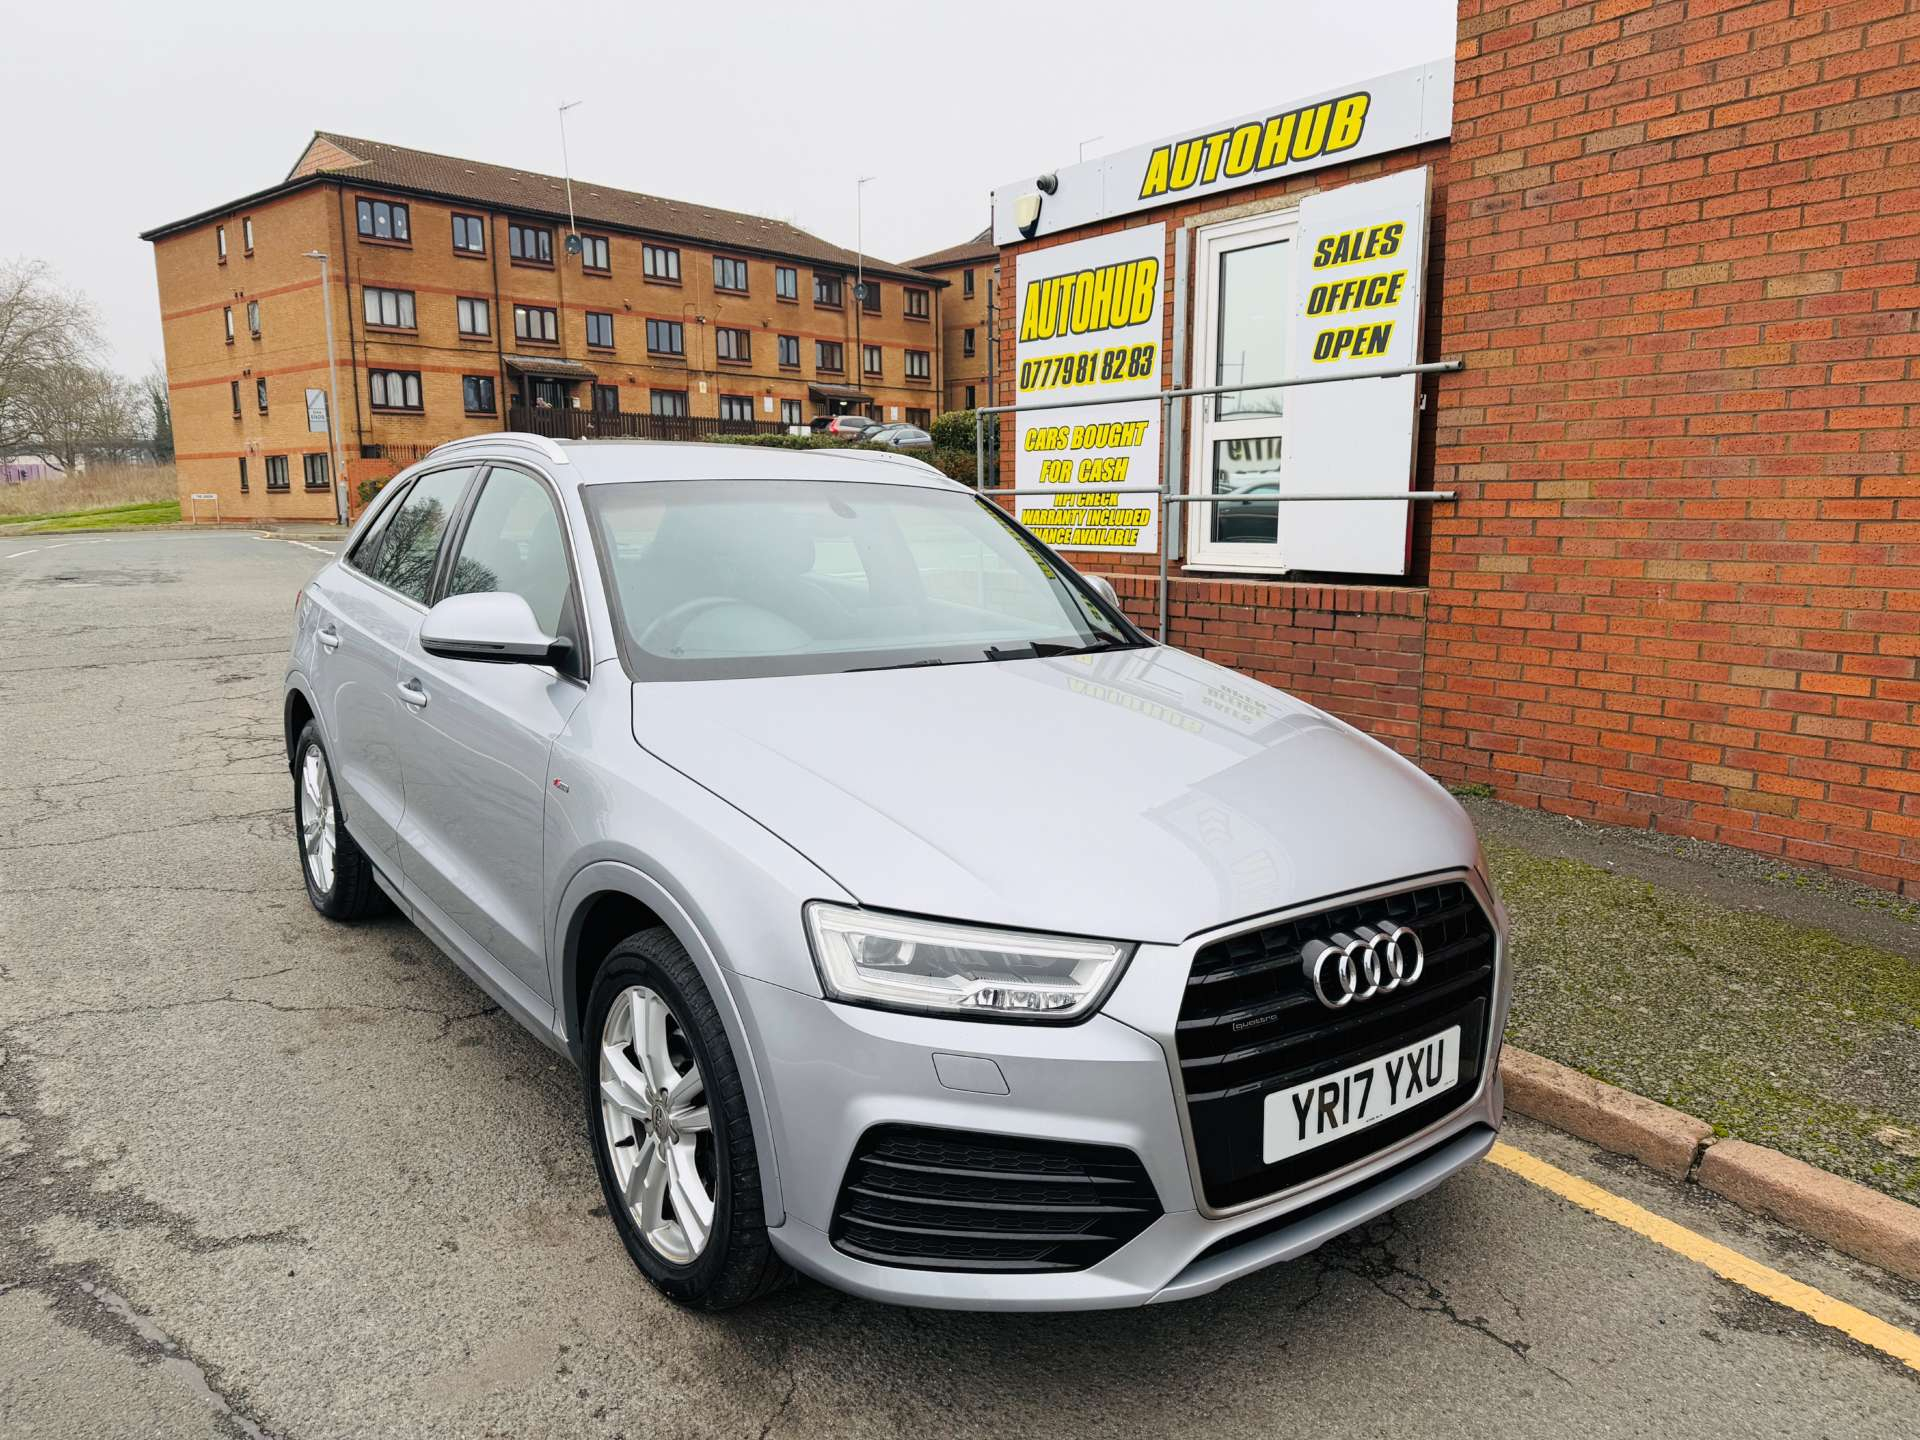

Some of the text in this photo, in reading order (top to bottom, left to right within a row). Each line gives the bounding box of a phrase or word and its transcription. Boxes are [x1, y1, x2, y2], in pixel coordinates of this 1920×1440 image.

[1138, 91, 1371, 200] AUTOHUB
[1312, 222, 1405, 269] SALES
[1019, 256, 1159, 343] AUTOHUB
[1305, 271, 1406, 316] OFFICE
[1312, 322, 1394, 361] OPEN
[1024, 420, 1150, 452] CARS BOUGHT
[1039, 457, 1130, 484] FOR CASH
[1022, 508, 1152, 527] WARRANTY INCLUDED
[1053, 492, 1120, 507] HPI CHECK
[1071, 528, 1140, 547] AVAILABLE
[1292, 1038, 1444, 1141] YR17 YXU
